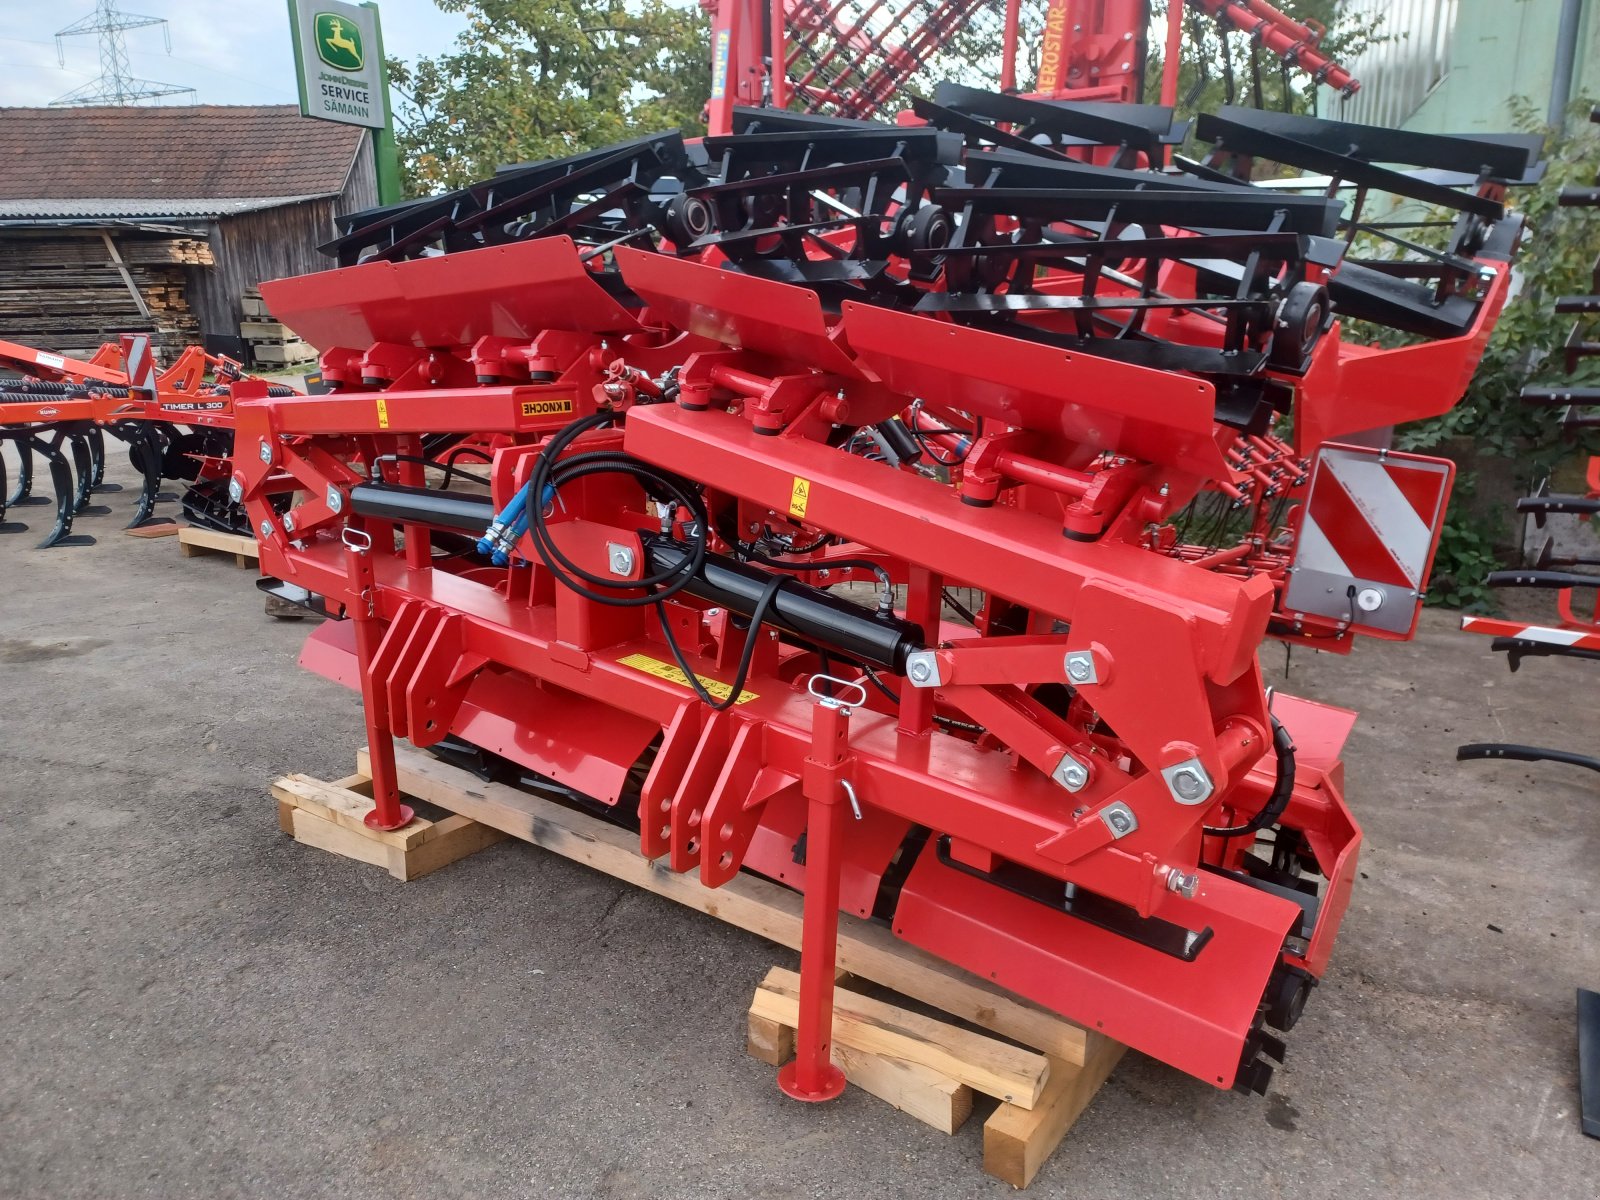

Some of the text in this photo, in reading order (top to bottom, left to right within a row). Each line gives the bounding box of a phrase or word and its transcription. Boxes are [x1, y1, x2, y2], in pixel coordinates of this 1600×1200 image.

[321, 84, 370, 104] SERVICE
[323, 99, 369, 119] SÄMANN
[523, 402, 563, 415] KNOCHE
